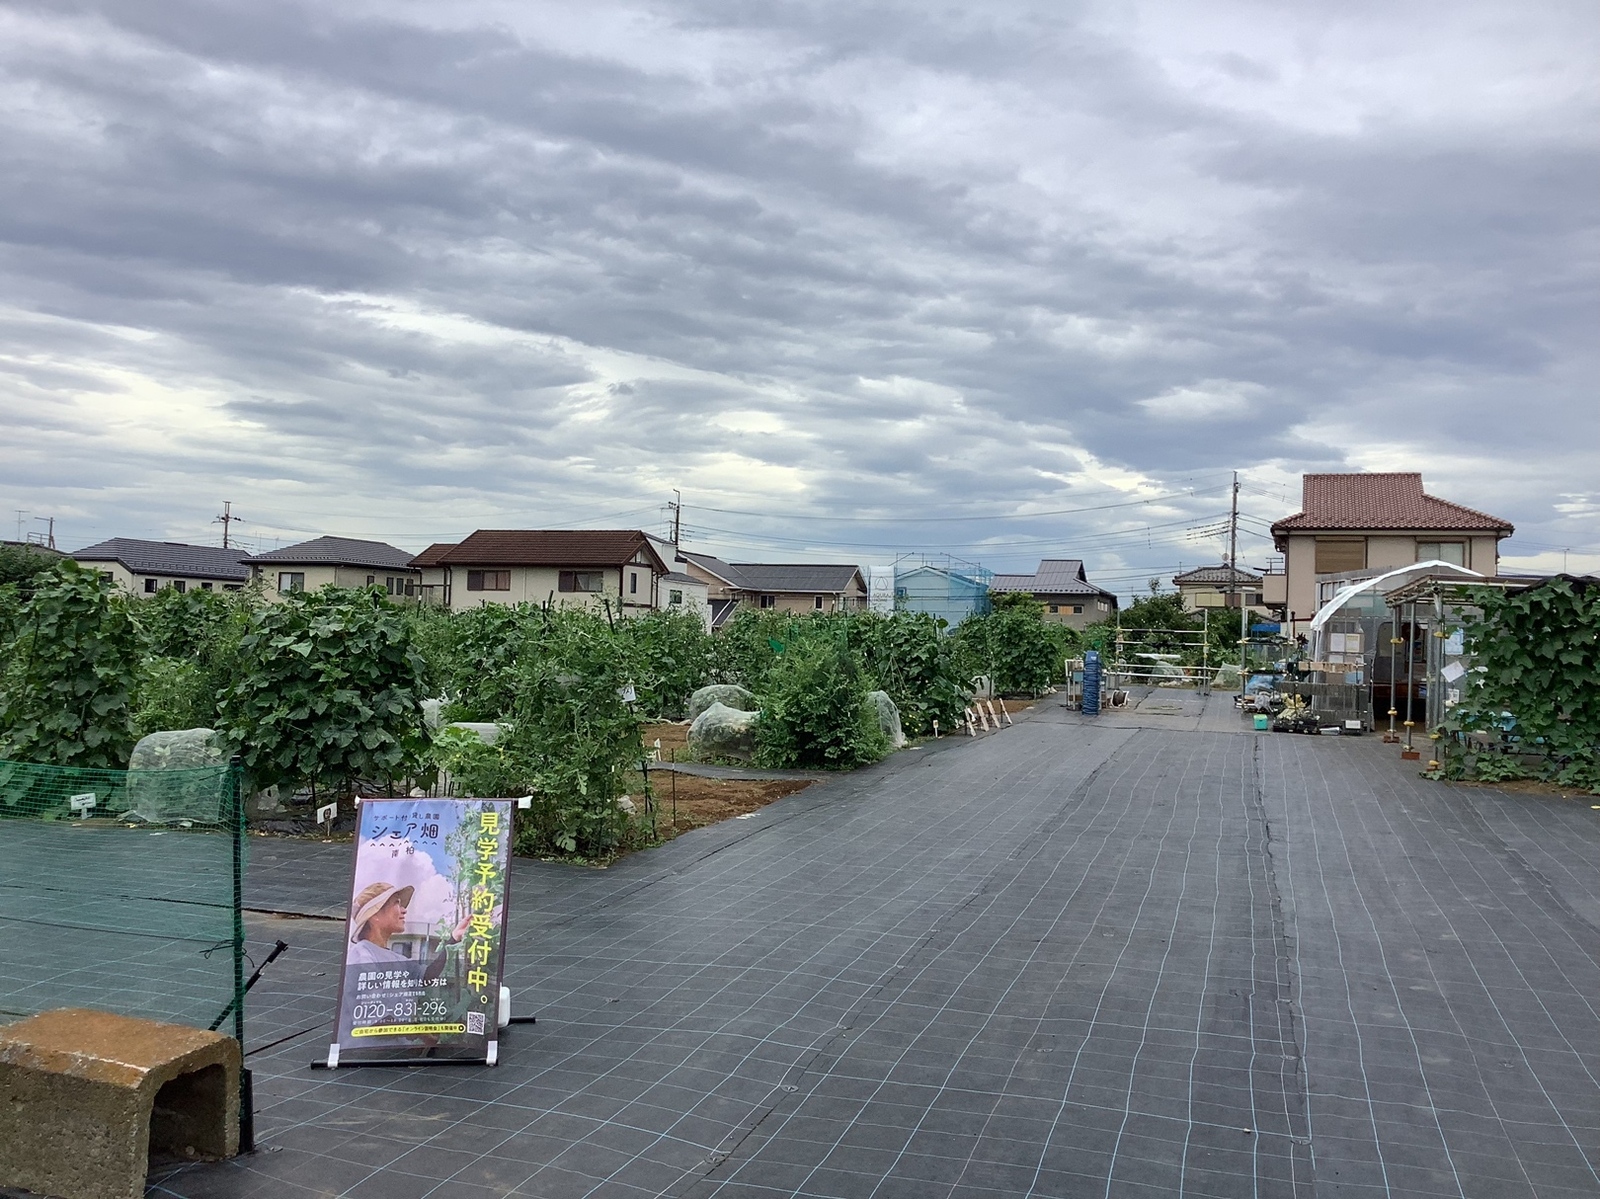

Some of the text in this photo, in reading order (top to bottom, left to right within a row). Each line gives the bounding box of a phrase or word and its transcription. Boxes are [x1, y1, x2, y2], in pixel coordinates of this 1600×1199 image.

[372, 823, 438, 839] シェア畑
[467, 812, 500, 1003] 見学予約受付中。
[358, 970, 410, 981] 農園の見学や
[353, 1002, 447, 1019] 0120-831-296
